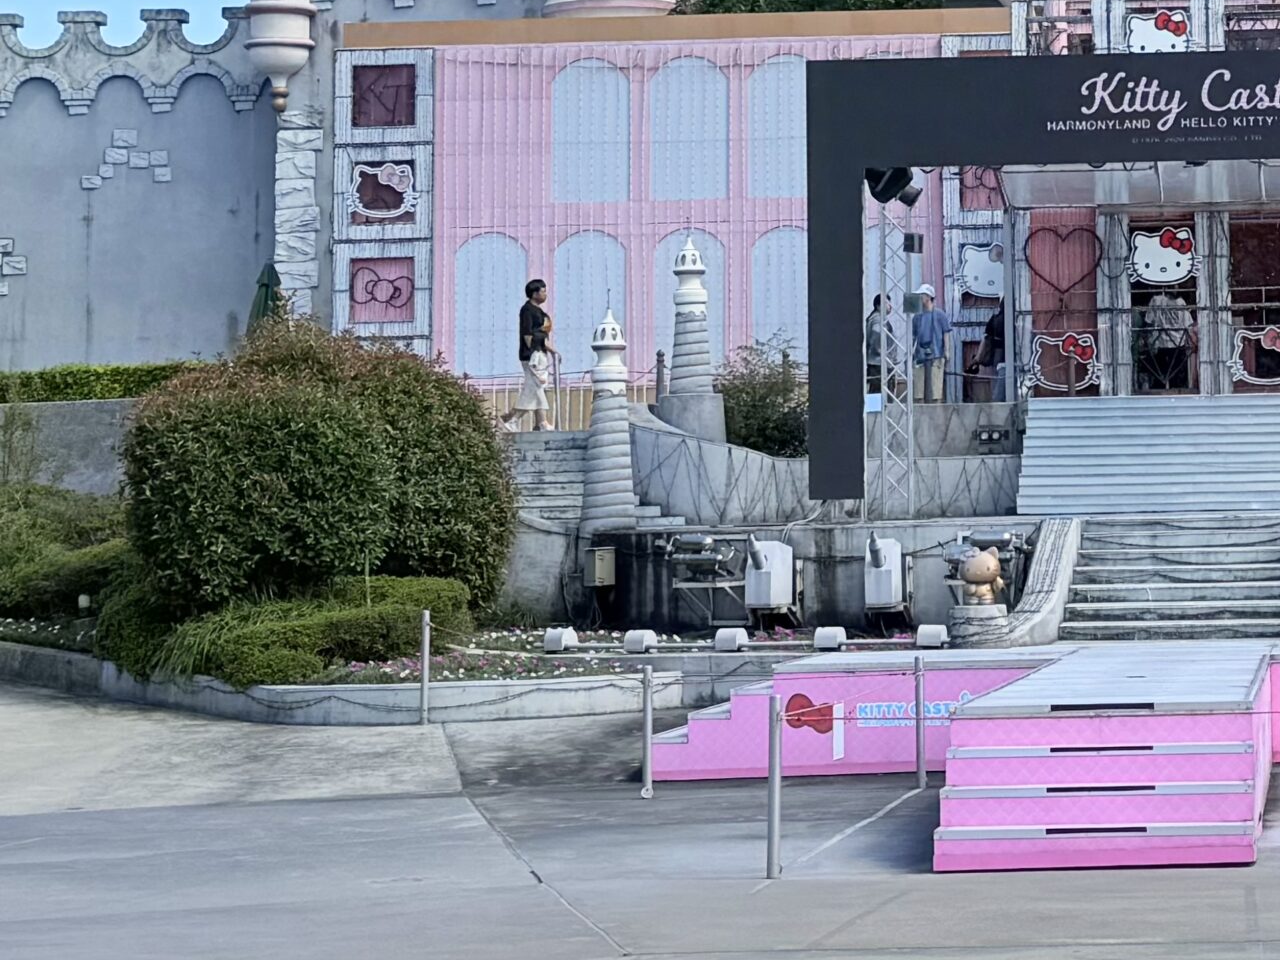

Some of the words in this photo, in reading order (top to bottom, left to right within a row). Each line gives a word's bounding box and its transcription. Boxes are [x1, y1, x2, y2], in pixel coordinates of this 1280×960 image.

[1081, 72, 1188, 132] Kitty
[1046, 118, 1151, 132] HARMONYLAND
[1180, 116, 1227, 129] HELLO
[858, 702, 906, 718] KITTY
